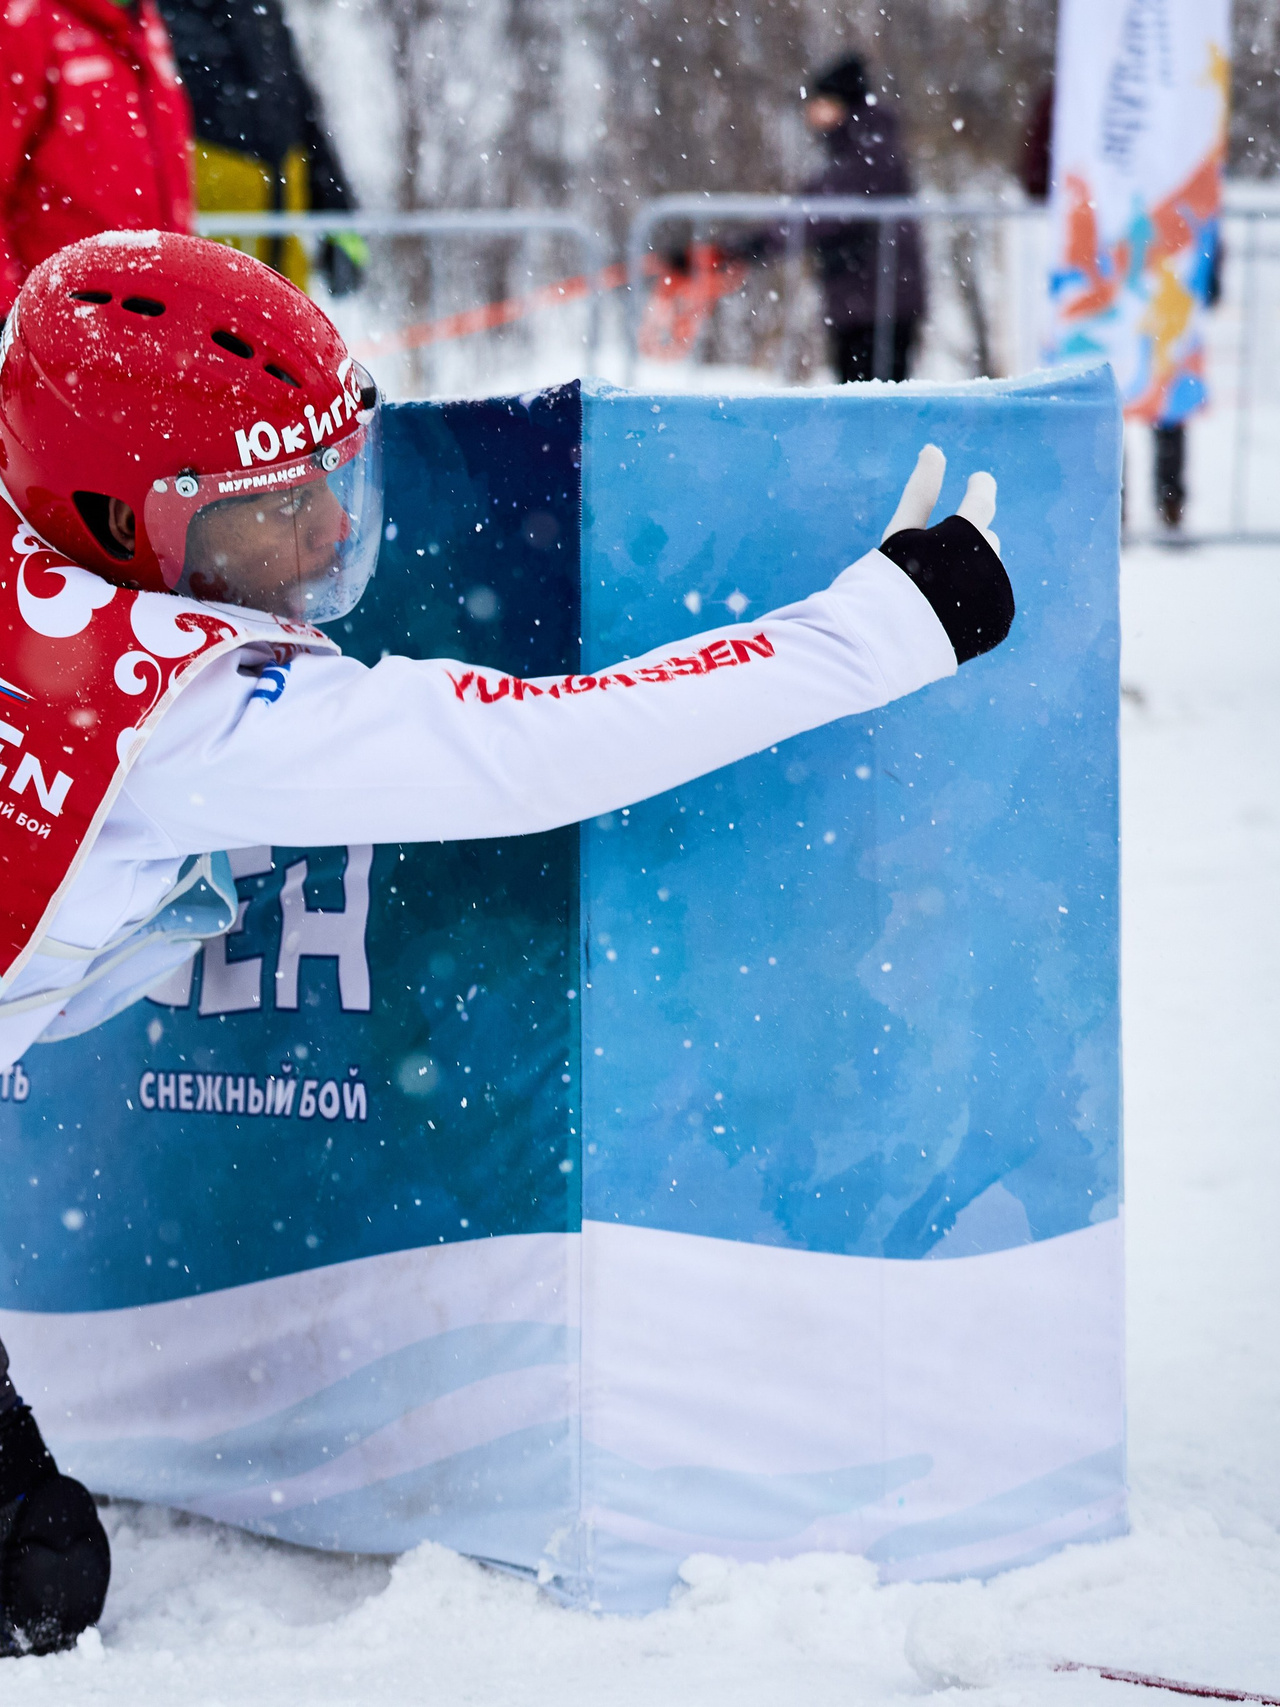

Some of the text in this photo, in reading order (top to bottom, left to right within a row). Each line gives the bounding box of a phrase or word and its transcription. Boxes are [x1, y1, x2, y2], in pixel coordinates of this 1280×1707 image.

[219, 464, 306, 494] МУРМАНСК
[15, 812, 52, 840] БОЙ
[138, 1063, 368, 1122] СНЕЖНЫЙ БОЙ
